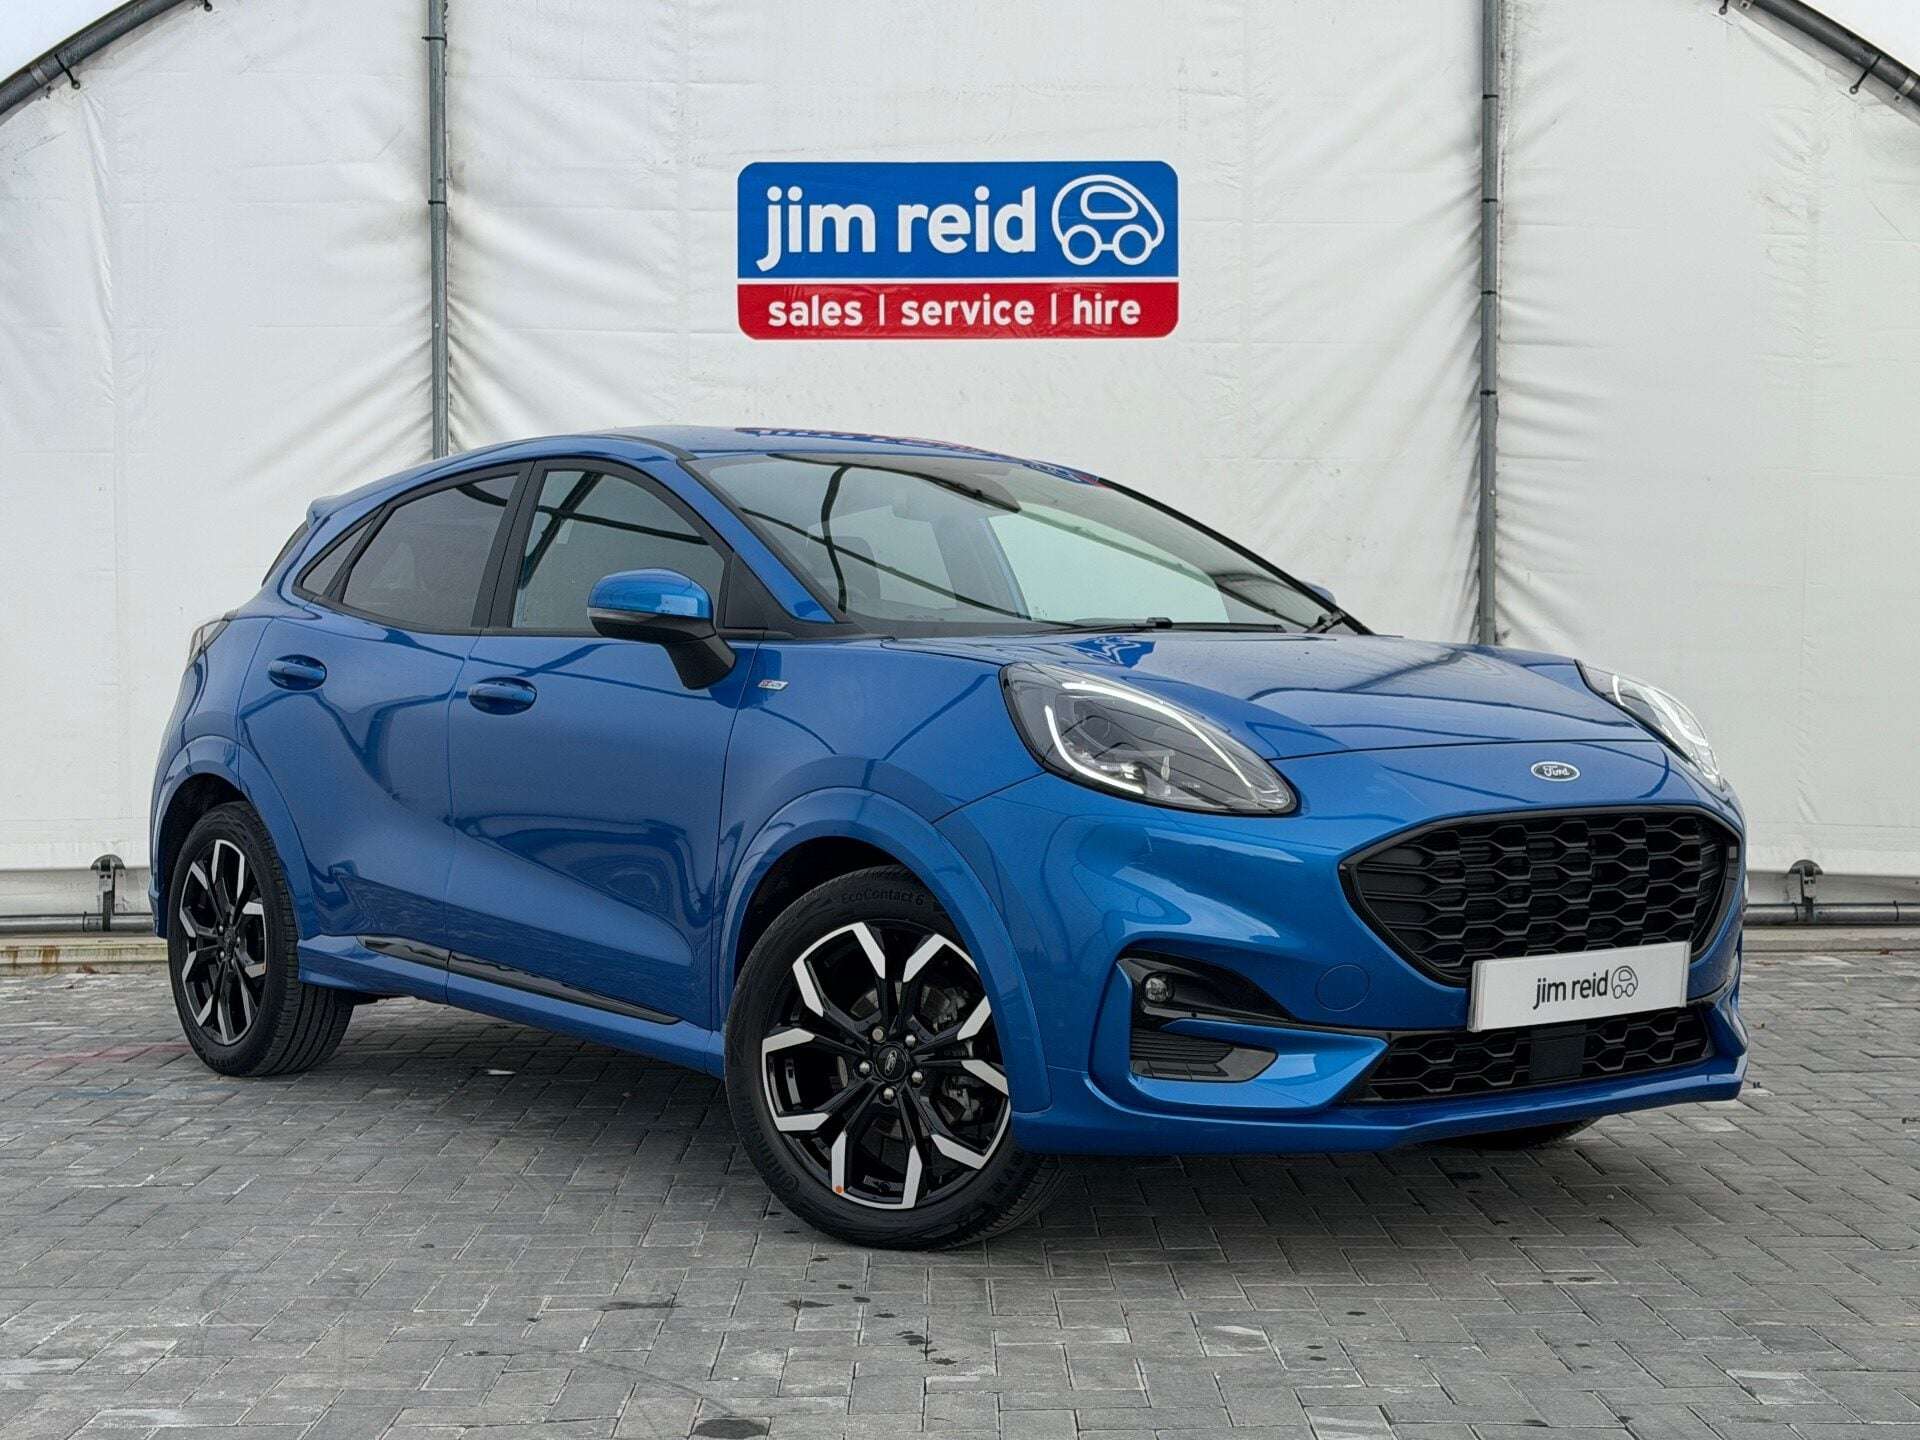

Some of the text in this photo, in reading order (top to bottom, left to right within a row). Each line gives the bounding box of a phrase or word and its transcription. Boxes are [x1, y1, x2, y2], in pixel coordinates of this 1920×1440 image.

[756, 185, 1036, 272] jim reid
[768, 292, 1141, 327] sales service hire
[1533, 969, 1609, 1011] jim reid
